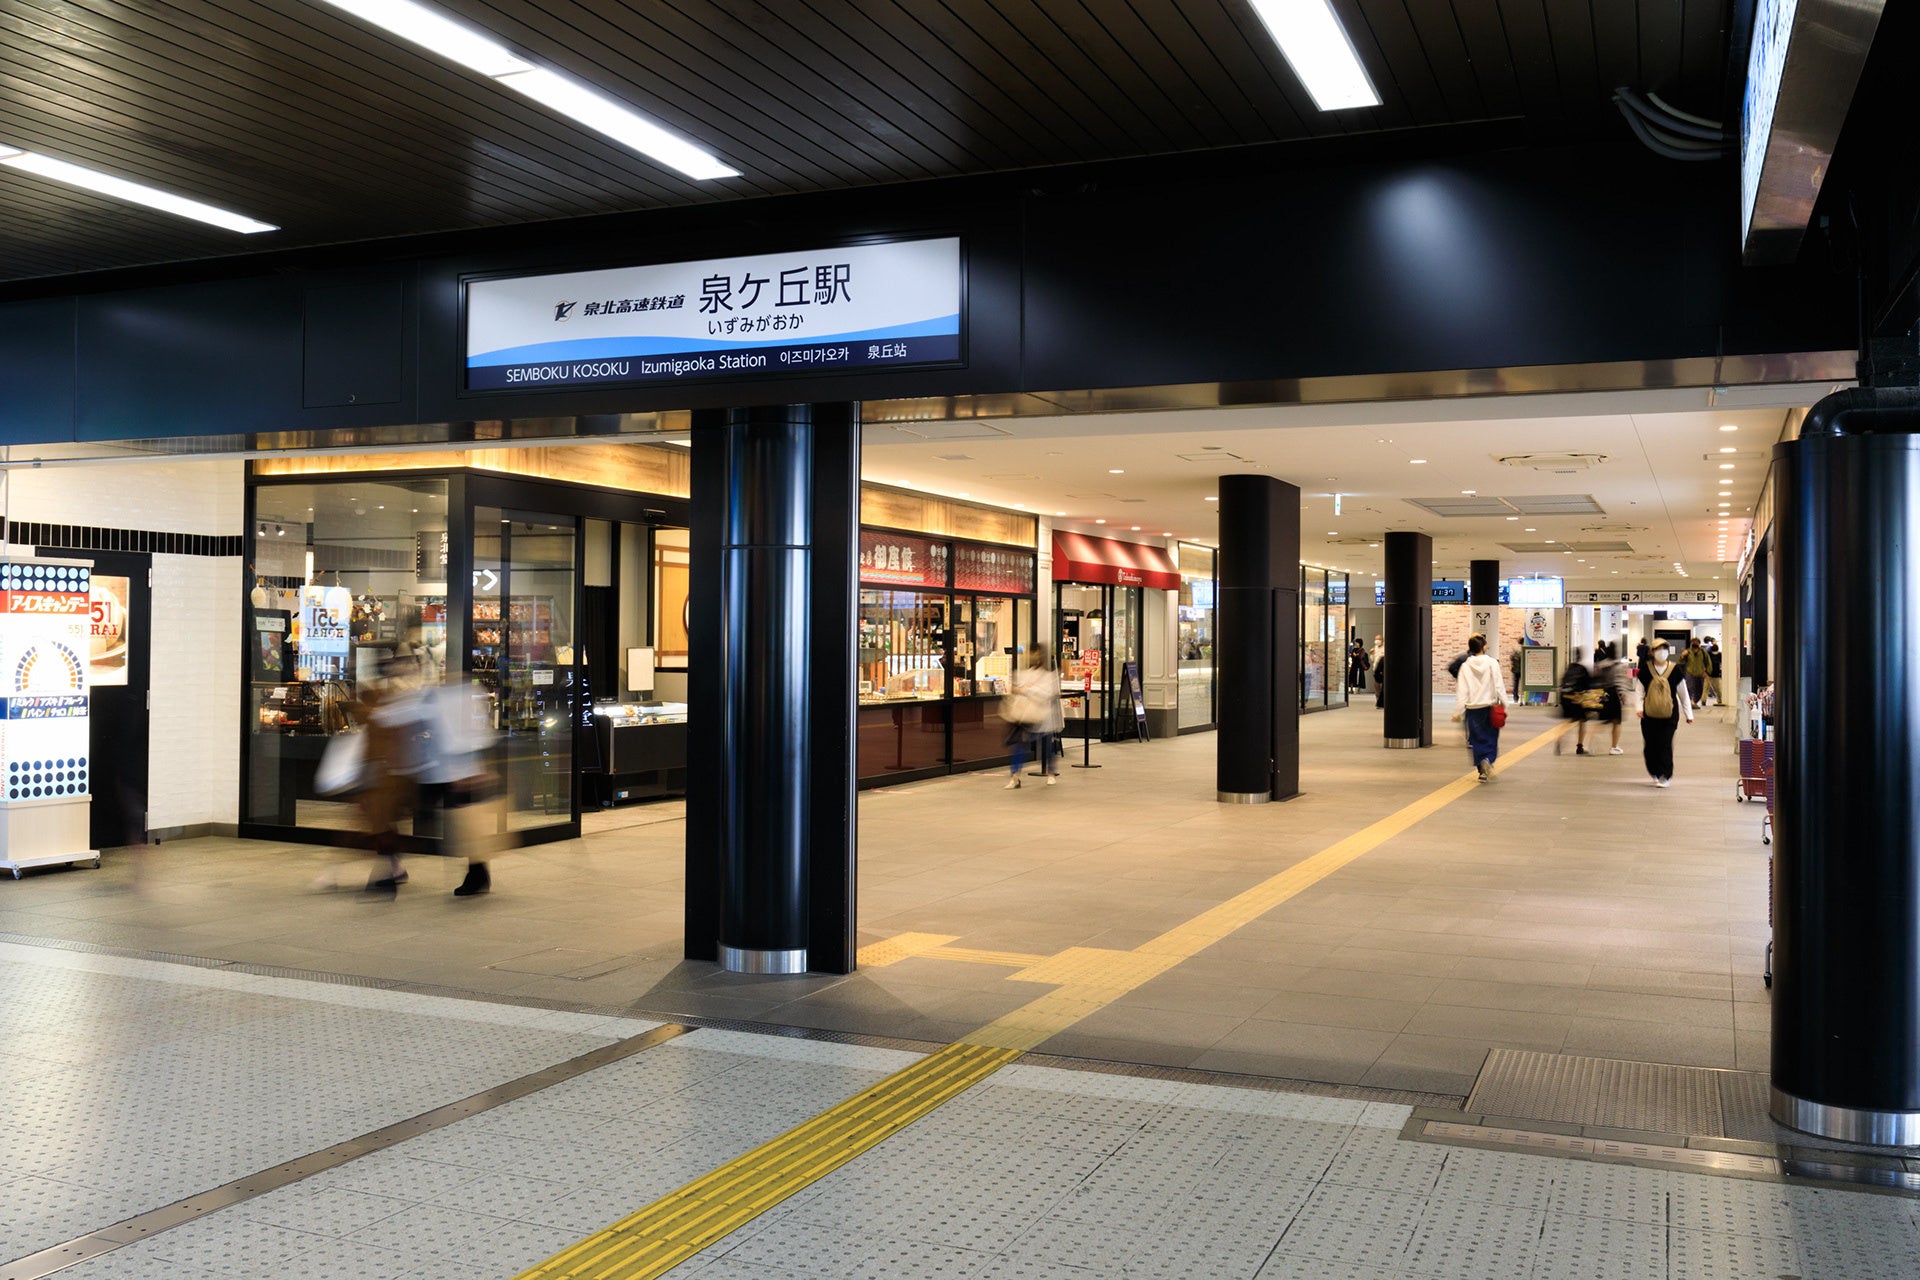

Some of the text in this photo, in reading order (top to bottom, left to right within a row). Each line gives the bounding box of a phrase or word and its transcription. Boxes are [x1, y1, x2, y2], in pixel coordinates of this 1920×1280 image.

[699, 263, 851, 314] 泉ケ丘駅
[584, 294, 685, 316] 泉北高速鉄道
[708, 312, 804, 335] いずみがおか
[780, 346, 849, 365] 이즈미가오카
[867, 342, 907, 360] 泉丘站
[506, 353, 767, 383] SEMBOKU KOSOKU Izumigaoka Station
[11, 595, 89, 613] アイスキャンデー
